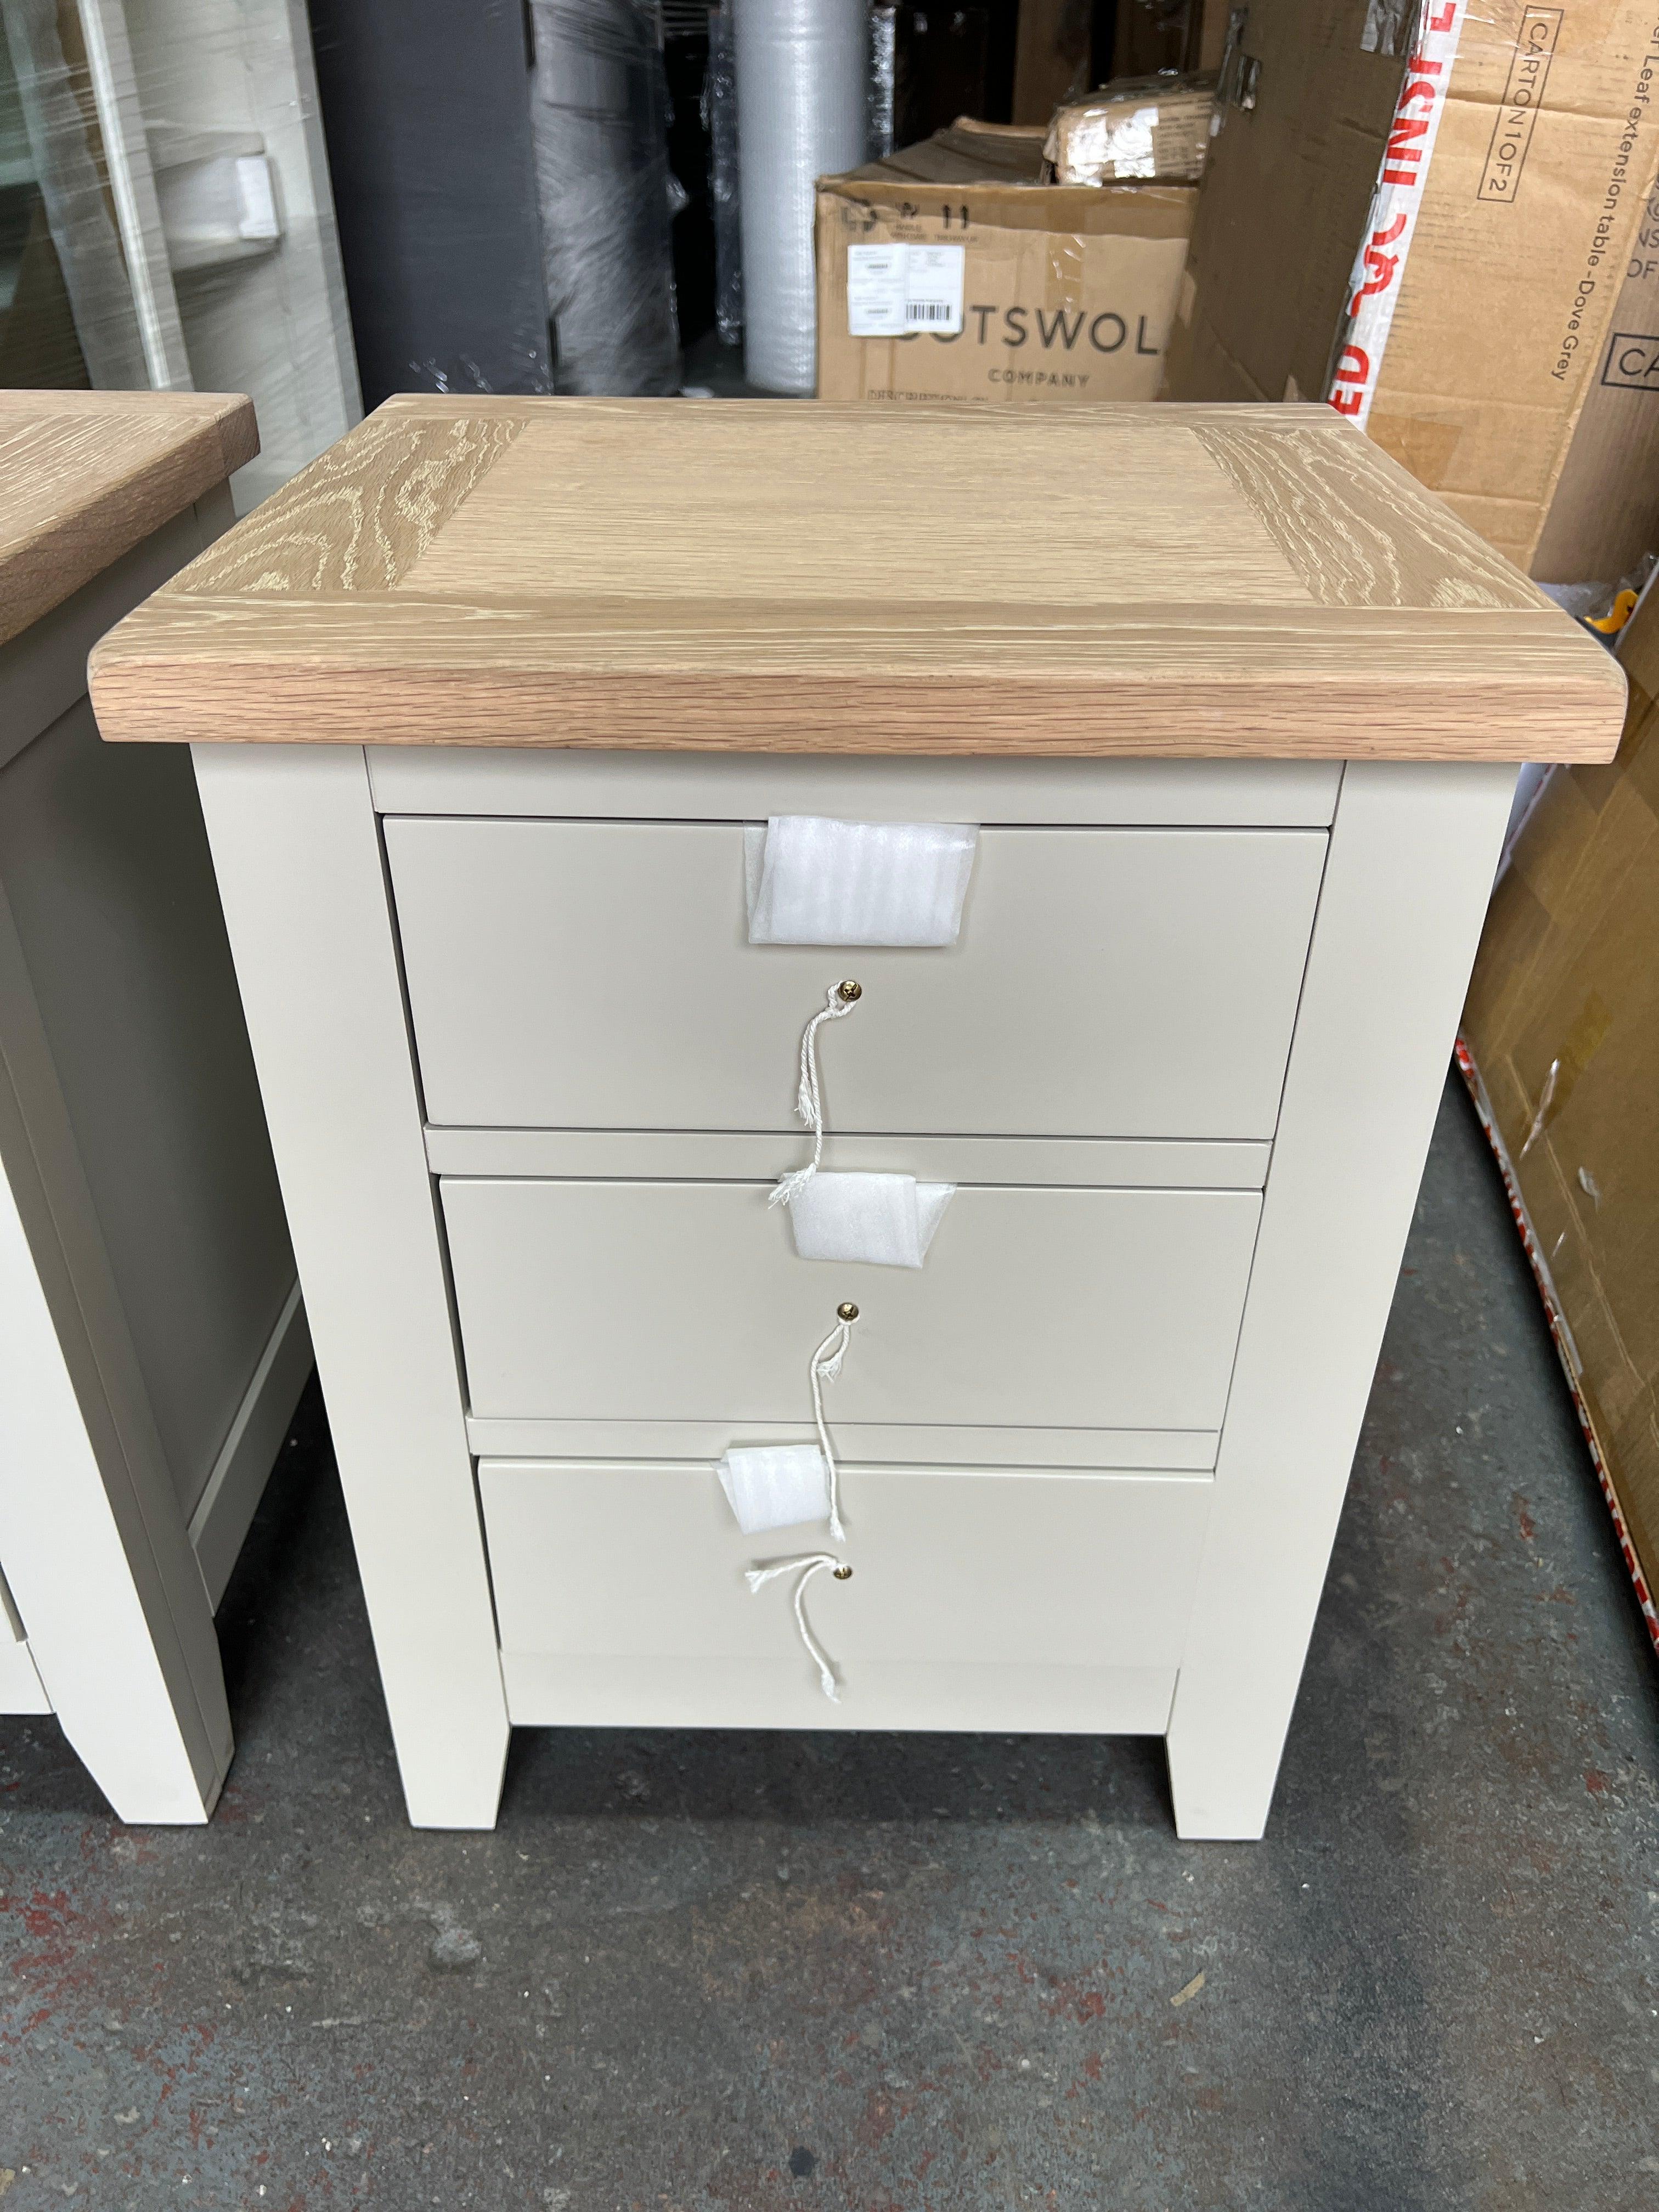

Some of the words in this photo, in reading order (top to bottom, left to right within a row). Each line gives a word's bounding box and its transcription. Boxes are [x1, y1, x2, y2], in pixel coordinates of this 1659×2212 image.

[1508, 22, 1548, 125] CARTON
[1634, 54, 1659, 104] Leaf
[1588, 215, 1615, 267] table
[988, 369, 1091, 389] COMPANY
[1551, 335, 1578, 381] Grey
